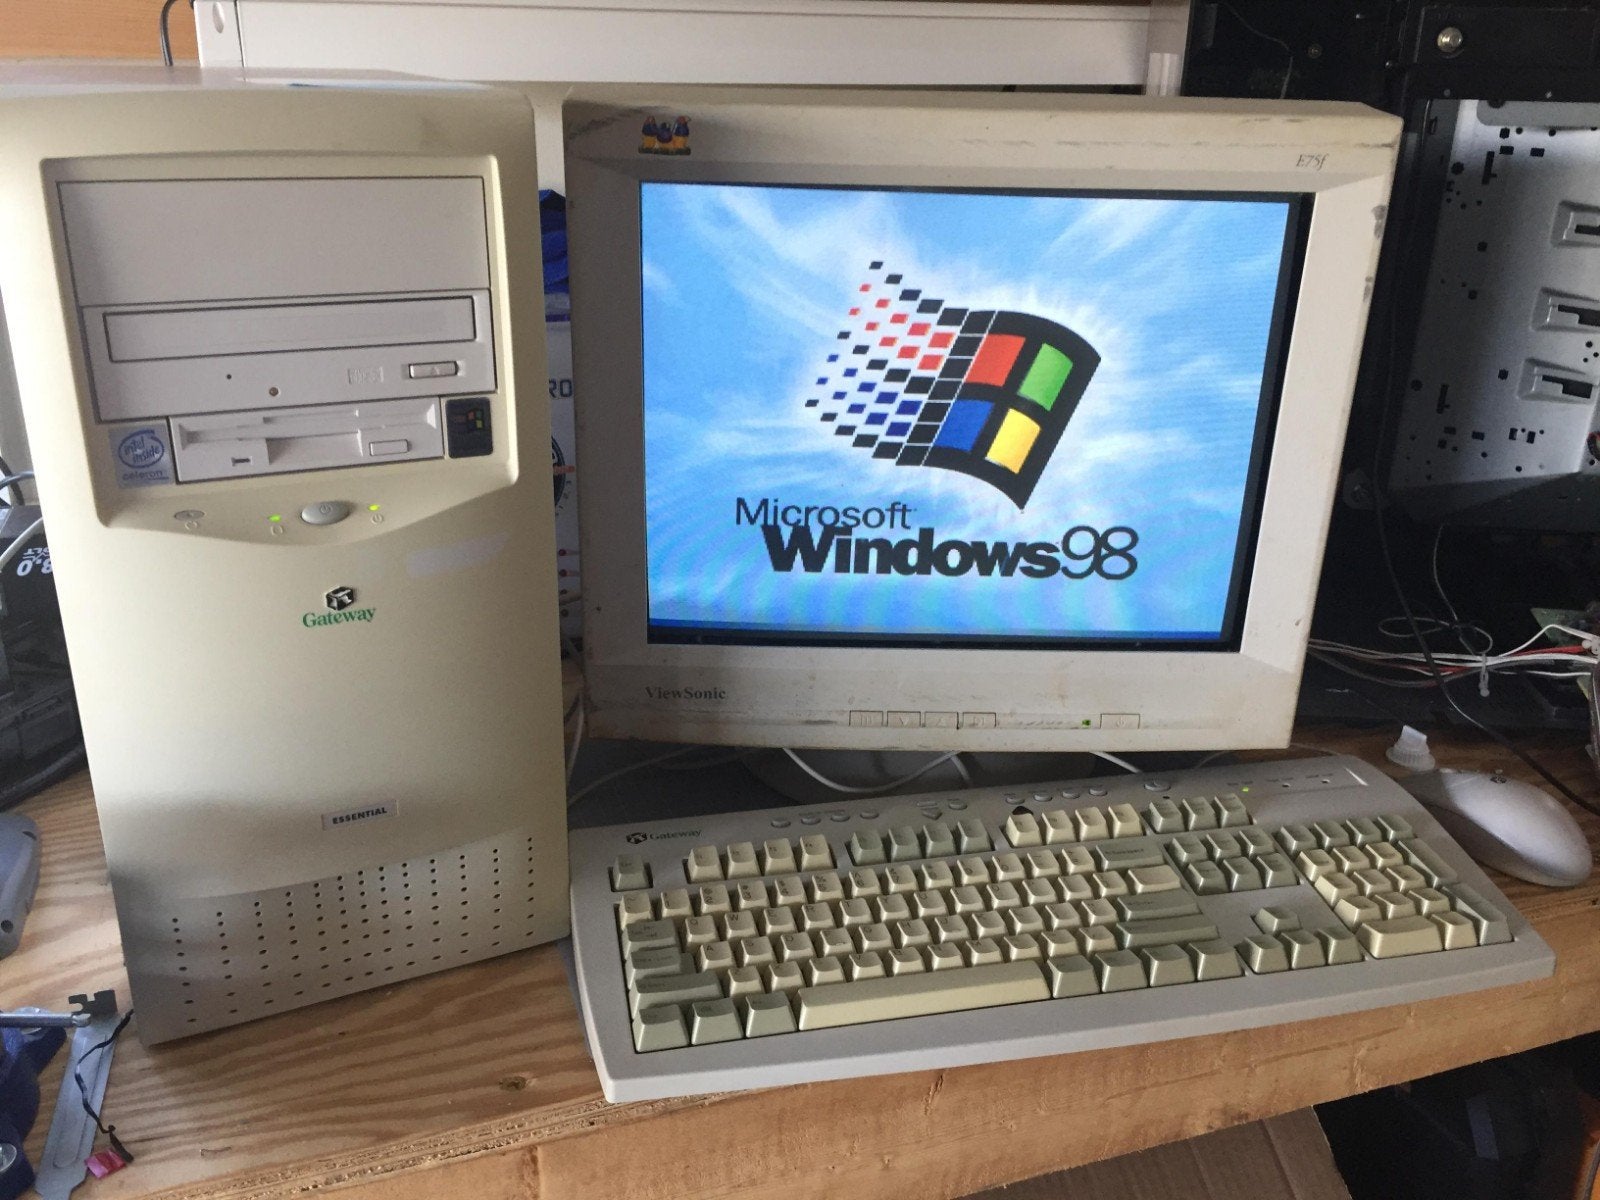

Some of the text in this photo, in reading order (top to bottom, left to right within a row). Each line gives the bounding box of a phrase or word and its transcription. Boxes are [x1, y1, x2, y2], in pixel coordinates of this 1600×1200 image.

[736, 497, 912, 530] Microsoft
[302, 607, 376, 628] Gateway
[645, 686, 726, 700] ViewSonic
[332, 806, 388, 825] ESSENTIAL
[649, 829, 702, 840] Gateway
